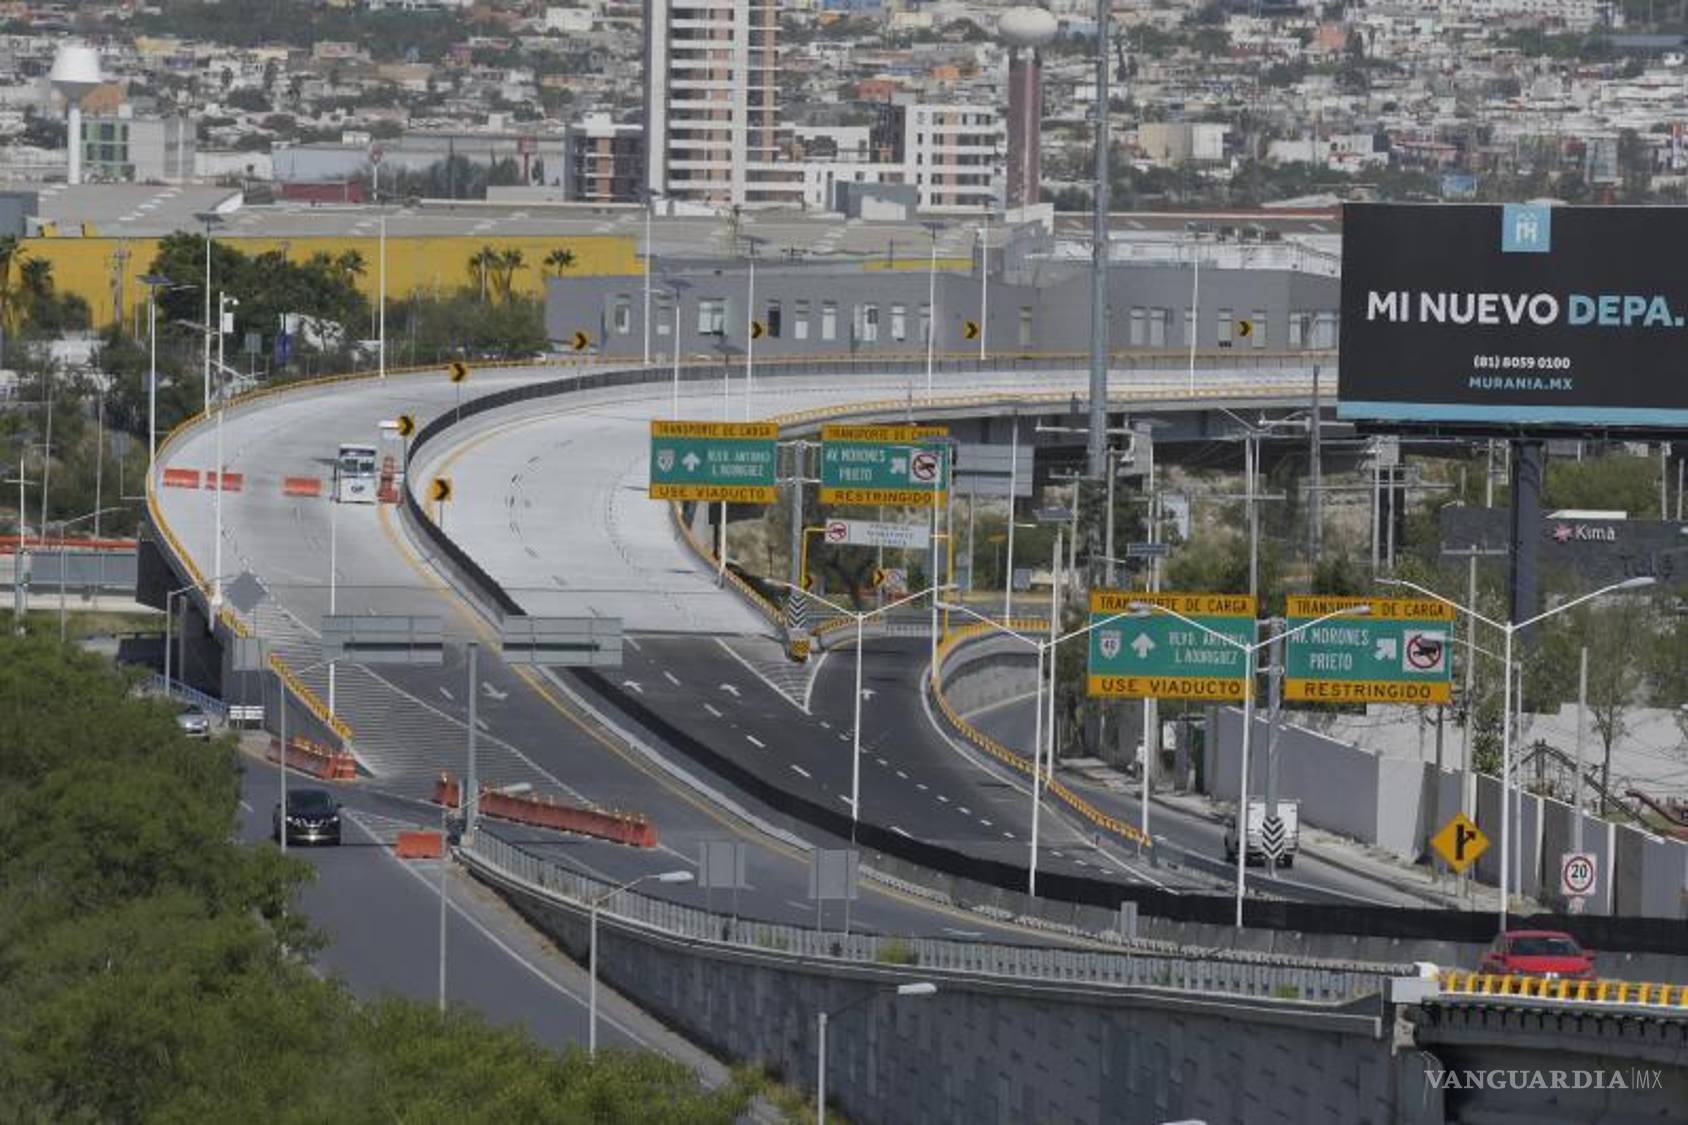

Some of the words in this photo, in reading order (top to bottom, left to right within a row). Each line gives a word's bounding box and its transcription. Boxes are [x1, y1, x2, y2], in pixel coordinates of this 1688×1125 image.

[1367, 291, 1408, 322] MI
[1420, 293, 1559, 324] NUEVO
[1567, 296, 1685, 326] DEPA.
[1473, 355, 1500, 369] (81)
[1502, 356, 1535, 369] 8059
[1537, 357, 1571, 369] 0100
[1468, 376, 1573, 390] MURANIA.MX
[659, 487, 689, 498] USE
[696, 488, 767, 499] VIADUCTO
[834, 490, 933, 502] RESTRINGIDO
[1185, 598, 1201, 613] DE
[1207, 599, 1247, 614] CARGA
[1382, 602, 1399, 616] DE
[1403, 603, 1444, 617] CARGA
[1311, 628, 1370, 646] MORONES
[1309, 653, 1353, 670] PRIETO
[1101, 678, 1138, 693] USE
[1150, 680, 1241, 695] VIADUCTO
[1304, 682, 1432, 699] RESTRINGIDO
[1571, 862, 1588, 879] 20
